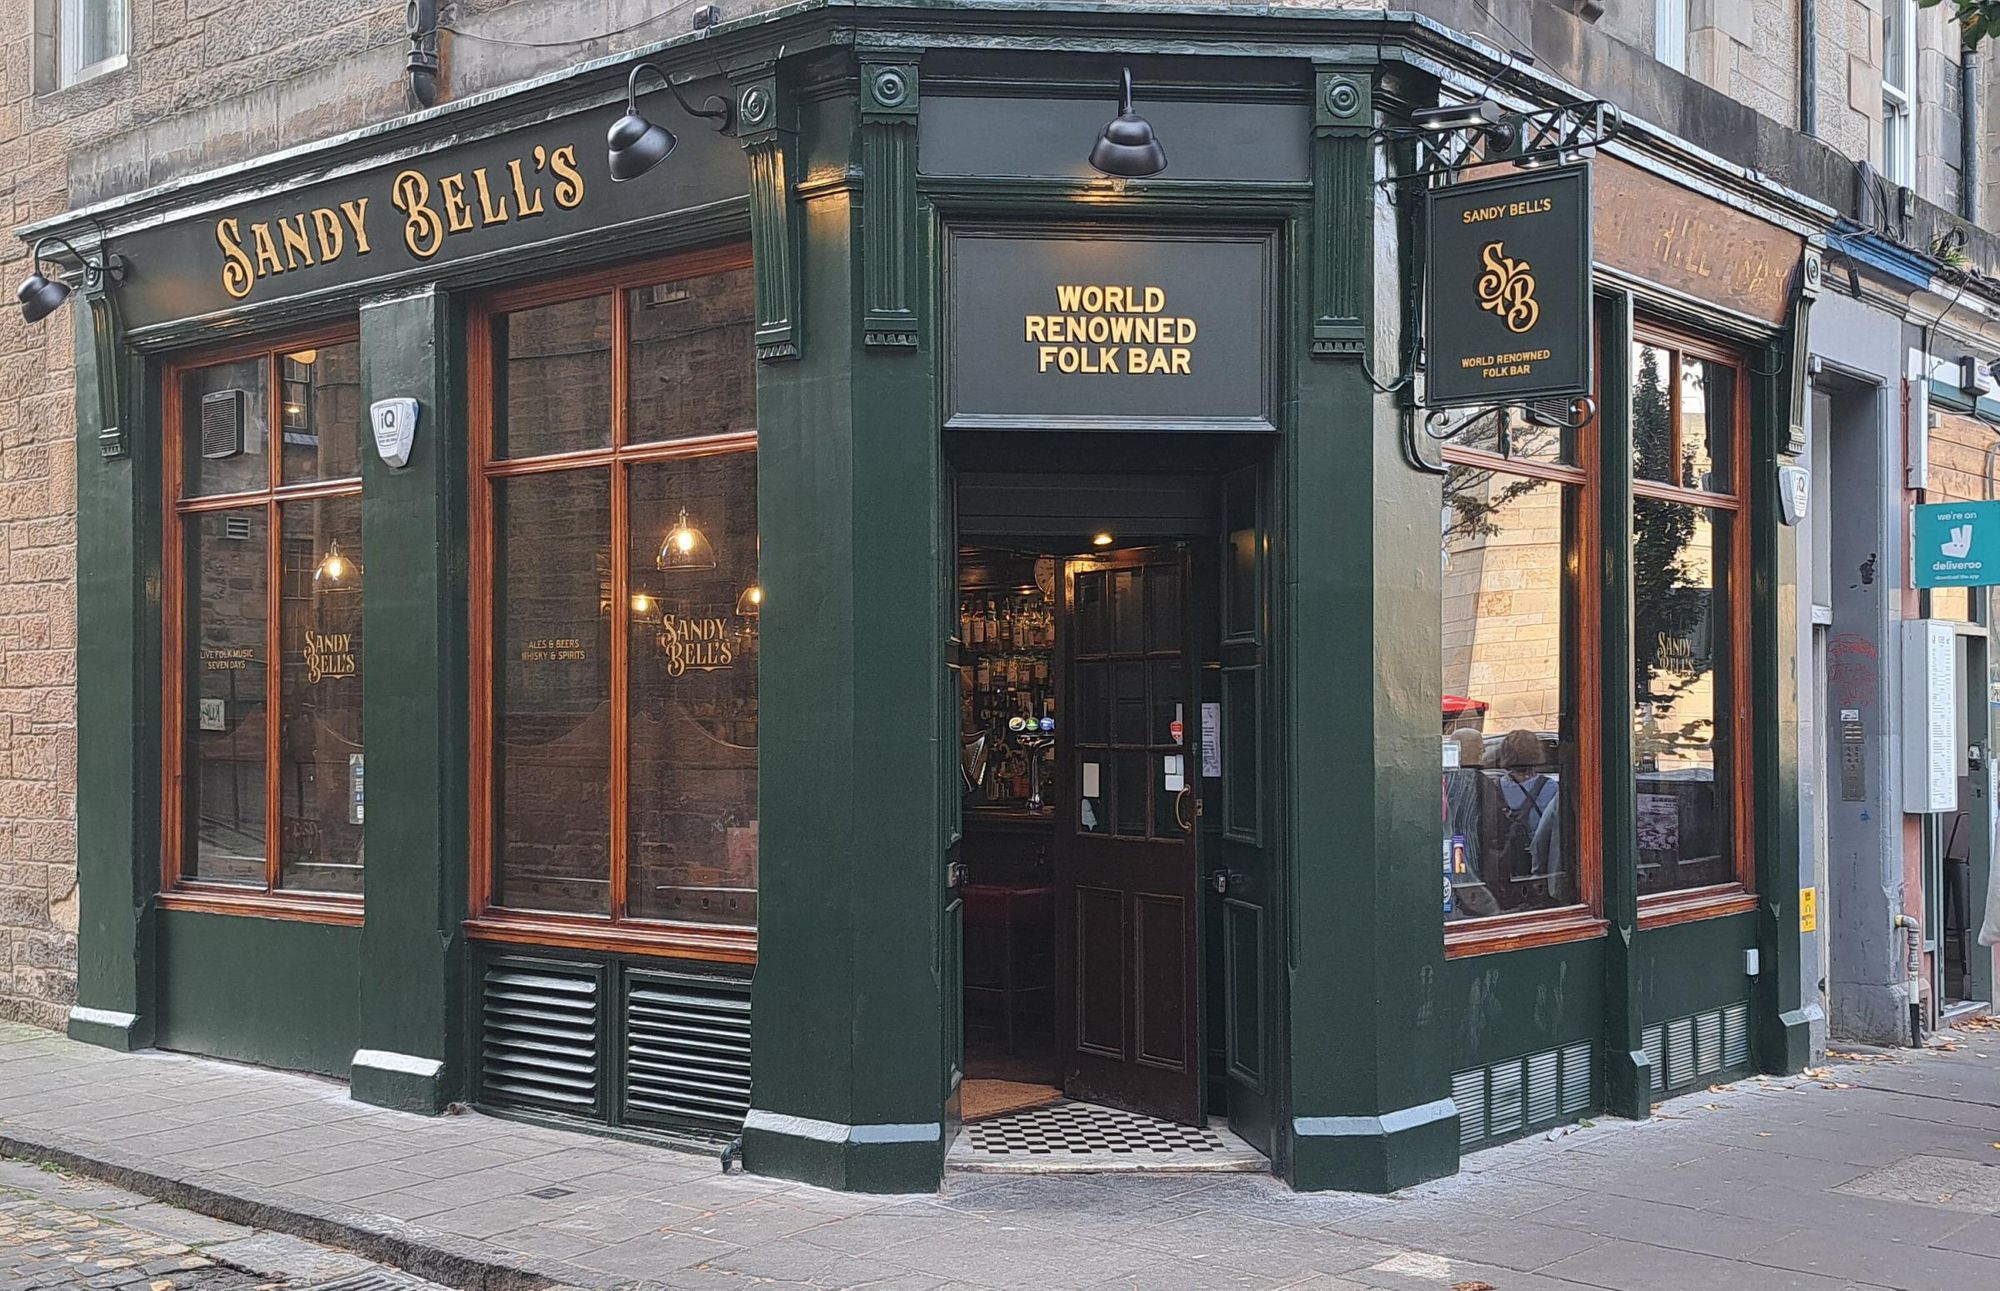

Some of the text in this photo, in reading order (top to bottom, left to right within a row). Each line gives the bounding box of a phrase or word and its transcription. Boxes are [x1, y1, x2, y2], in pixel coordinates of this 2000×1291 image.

[216, 144, 586, 299] SANDY BELL'S
[1463, 198, 1552, 223] SANDY BELL'S
[1057, 285, 1166, 313] WORLD
[1025, 315, 1197, 344] RENOWNED
[1039, 346, 1191, 375] FOLK BAR
[1461, 350, 1551, 368] WORLD RENOWNED
[1483, 365, 1531, 379] FOLK BAR
[1937, 511, 1978, 521] we're on
[1932, 560, 1982, 571] deliveroo
[661, 613, 728, 648] SANDY
[200, 649, 254, 659] LIVE FOLK MUSIC
[303, 630, 352, 659] SANDY
[528, 640, 547, 649] ALES
[555, 639, 580, 648] BEERS
[558, 650, 585, 660] SPIRITS
[1657, 631, 1692, 661] SANDY
[207, 660, 246, 670] SEVEN DAYS
[306, 653, 356, 684] BELL'S
[665, 641, 733, 677] BELL'S
